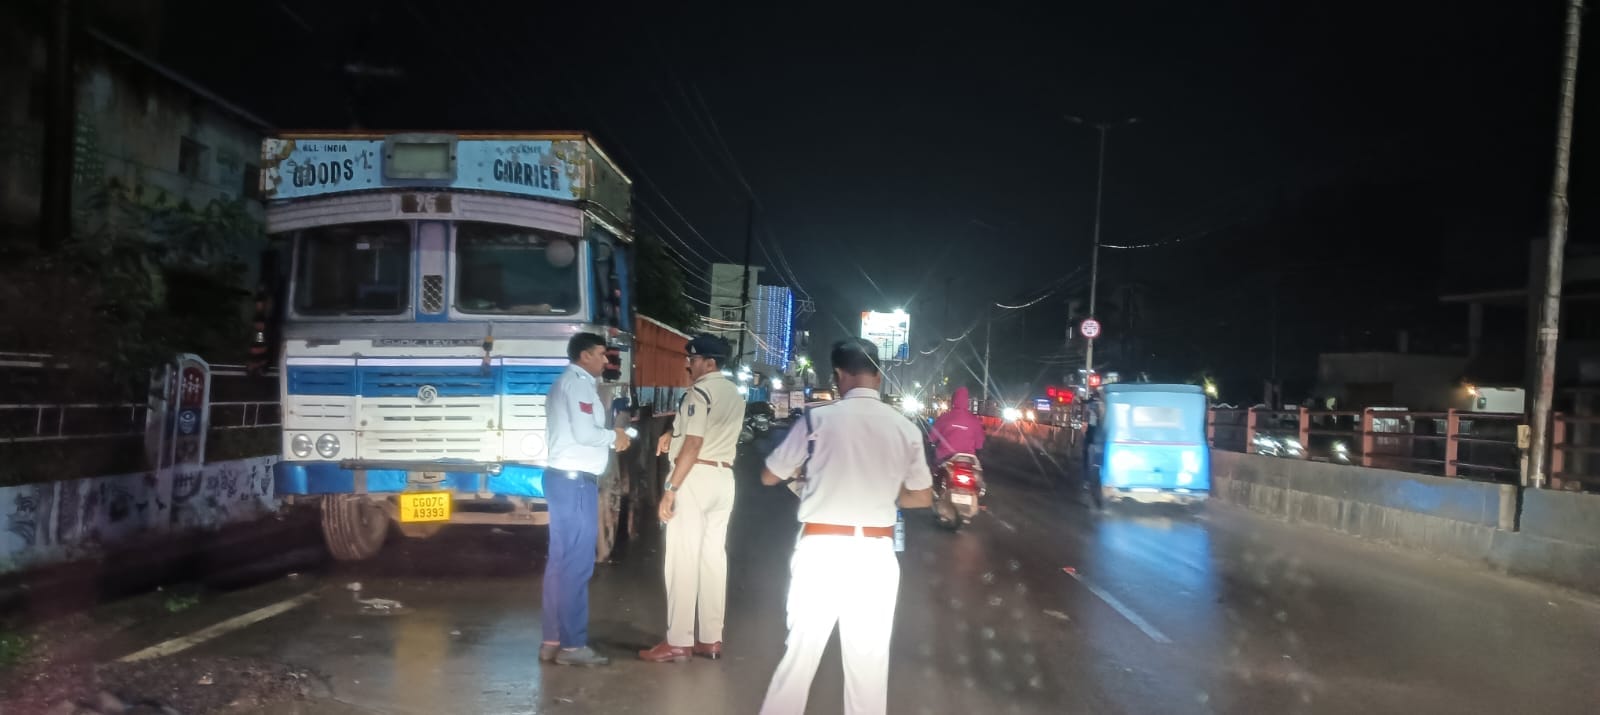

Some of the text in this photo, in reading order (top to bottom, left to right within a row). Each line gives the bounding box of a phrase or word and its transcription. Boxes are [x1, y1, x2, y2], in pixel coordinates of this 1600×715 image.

[302, 144, 347, 153] ALL INDIA
[292, 158, 354, 188] GOODS
[493, 158, 561, 191] CARRIER
[412, 496, 444, 508] CG07C
[413, 507, 445, 519] A9393
